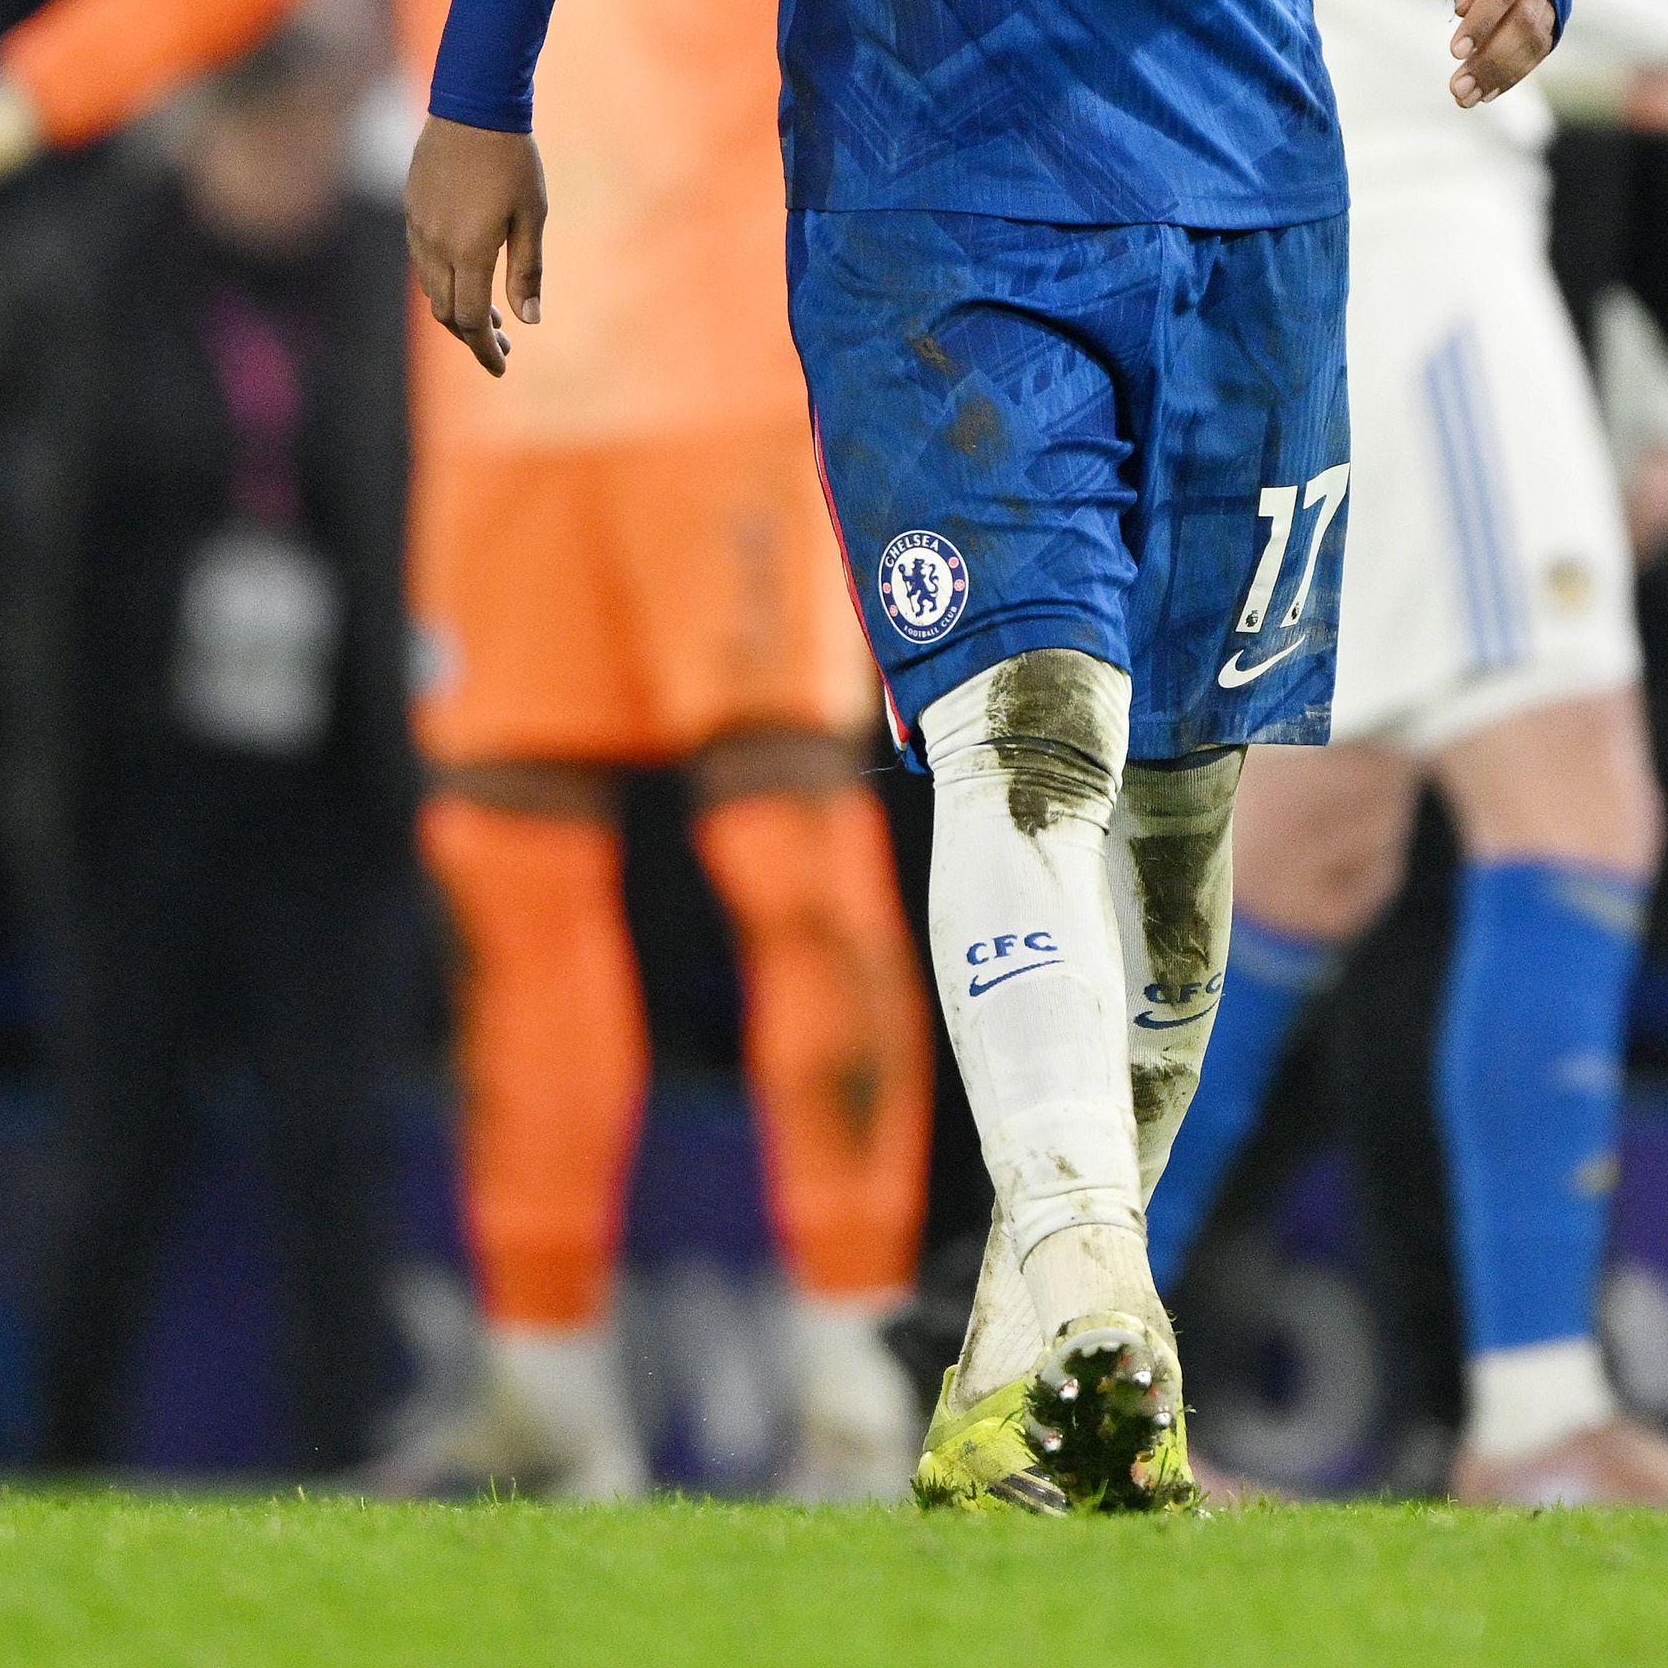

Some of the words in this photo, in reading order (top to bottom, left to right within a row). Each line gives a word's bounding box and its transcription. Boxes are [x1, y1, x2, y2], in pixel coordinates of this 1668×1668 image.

[885, 535, 939, 567] CHELSEA
[1235, 462, 1350, 633] 17
[966, 932, 1058, 966] CFC
[1143, 972, 1223, 1004] CFC
